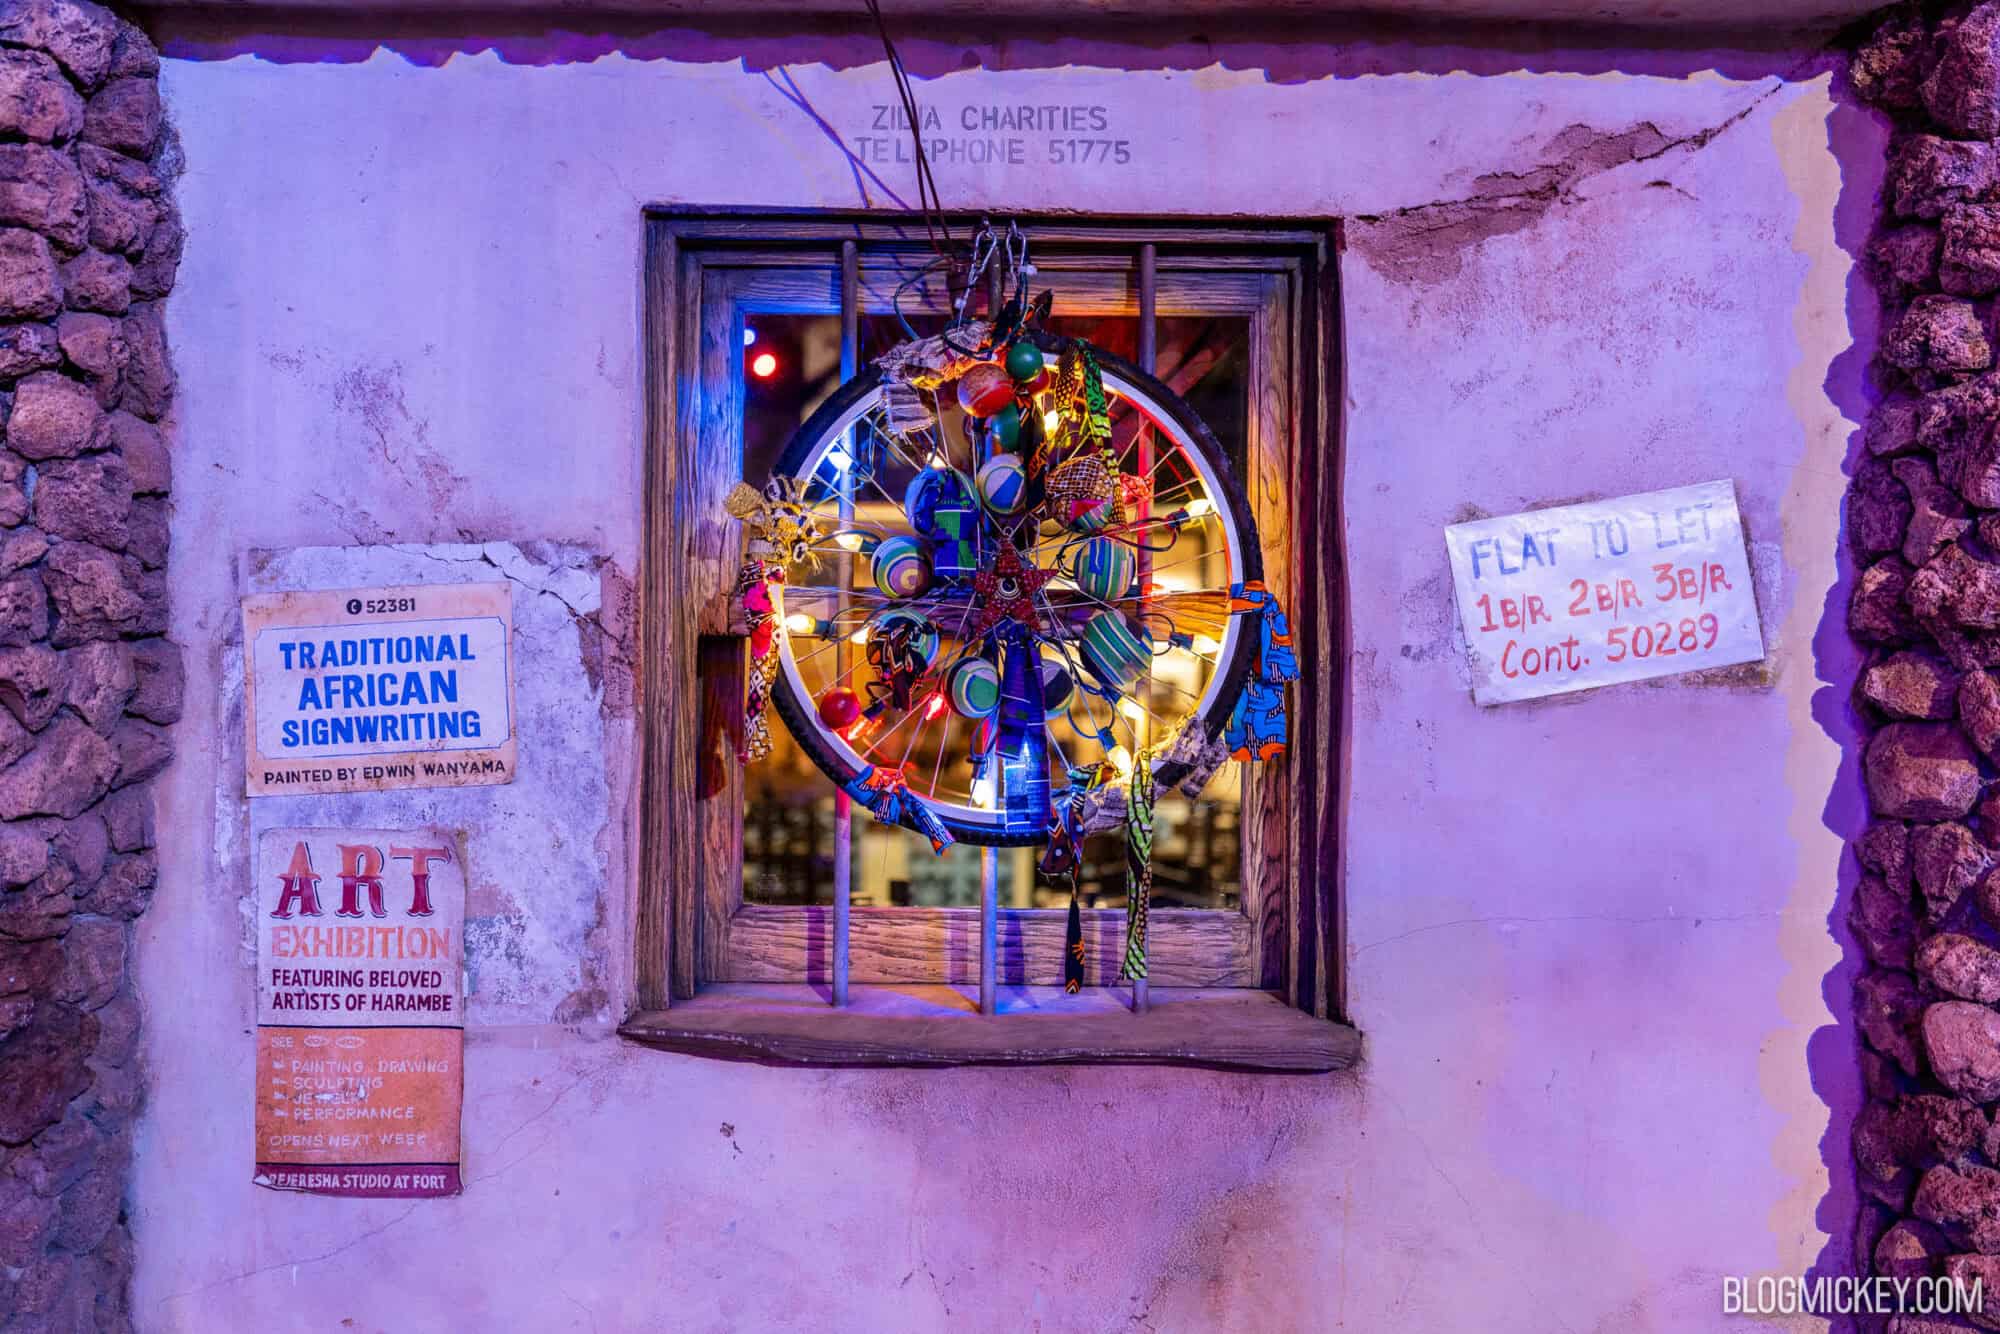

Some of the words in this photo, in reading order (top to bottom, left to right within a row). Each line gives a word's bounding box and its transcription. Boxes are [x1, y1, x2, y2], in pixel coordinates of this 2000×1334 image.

[960, 105, 1108, 131] CHARITIES
[854, 136, 1024, 164] TELEPHONE
[1049, 139, 1131, 165] 51775
[1470, 527, 1561, 580] FLAT
[1585, 516, 1629, 559] TO
[1650, 501, 1713, 549] LET
[366, 597, 416, 614] 52381
[1475, 593, 1552, 633] 1B/R
[1568, 577, 1643, 621] 2B/R
[1651, 559, 1732, 605] 3B/R
[279, 633, 476, 671] TRADITIONAL
[1500, 632, 1590, 679] Cont.
[1606, 612, 1719, 663] 50289
[298, 669, 458, 711] AFRICAN
[281, 710, 481, 747] SIGNWRITING
[263, 768, 333, 785] PAINTED
[337, 768, 357, 782] BY
[362, 764, 415, 781] EDWIN
[422, 759, 506, 777] WANYAMA
[270, 840, 452, 919] ART
[271, 925, 449, 960] EXHIBITION
[271, 968, 364, 989] FEATURING
[369, 970, 442, 989] BELOVED
[271, 992, 340, 1011] ARTISTS
[345, 993, 367, 1010] OF
[371, 994, 453, 1012] HARAMBE
[271, 1036, 295, 1049] SEE
[291, 1060, 365, 1073] PAINTING
[378, 1060, 449, 1073] DRAWING
[294, 1107, 416, 1121] PERFORMANCE
[270, 1135, 323, 1147] OPENS
[328, 1134, 370, 1147] NEXT
[379, 1133, 427, 1146] WEEK
[343, 1174, 389, 1189] STUDIO
[393, 1175, 409, 1189] AT
[413, 1175, 447, 1189] FORT
